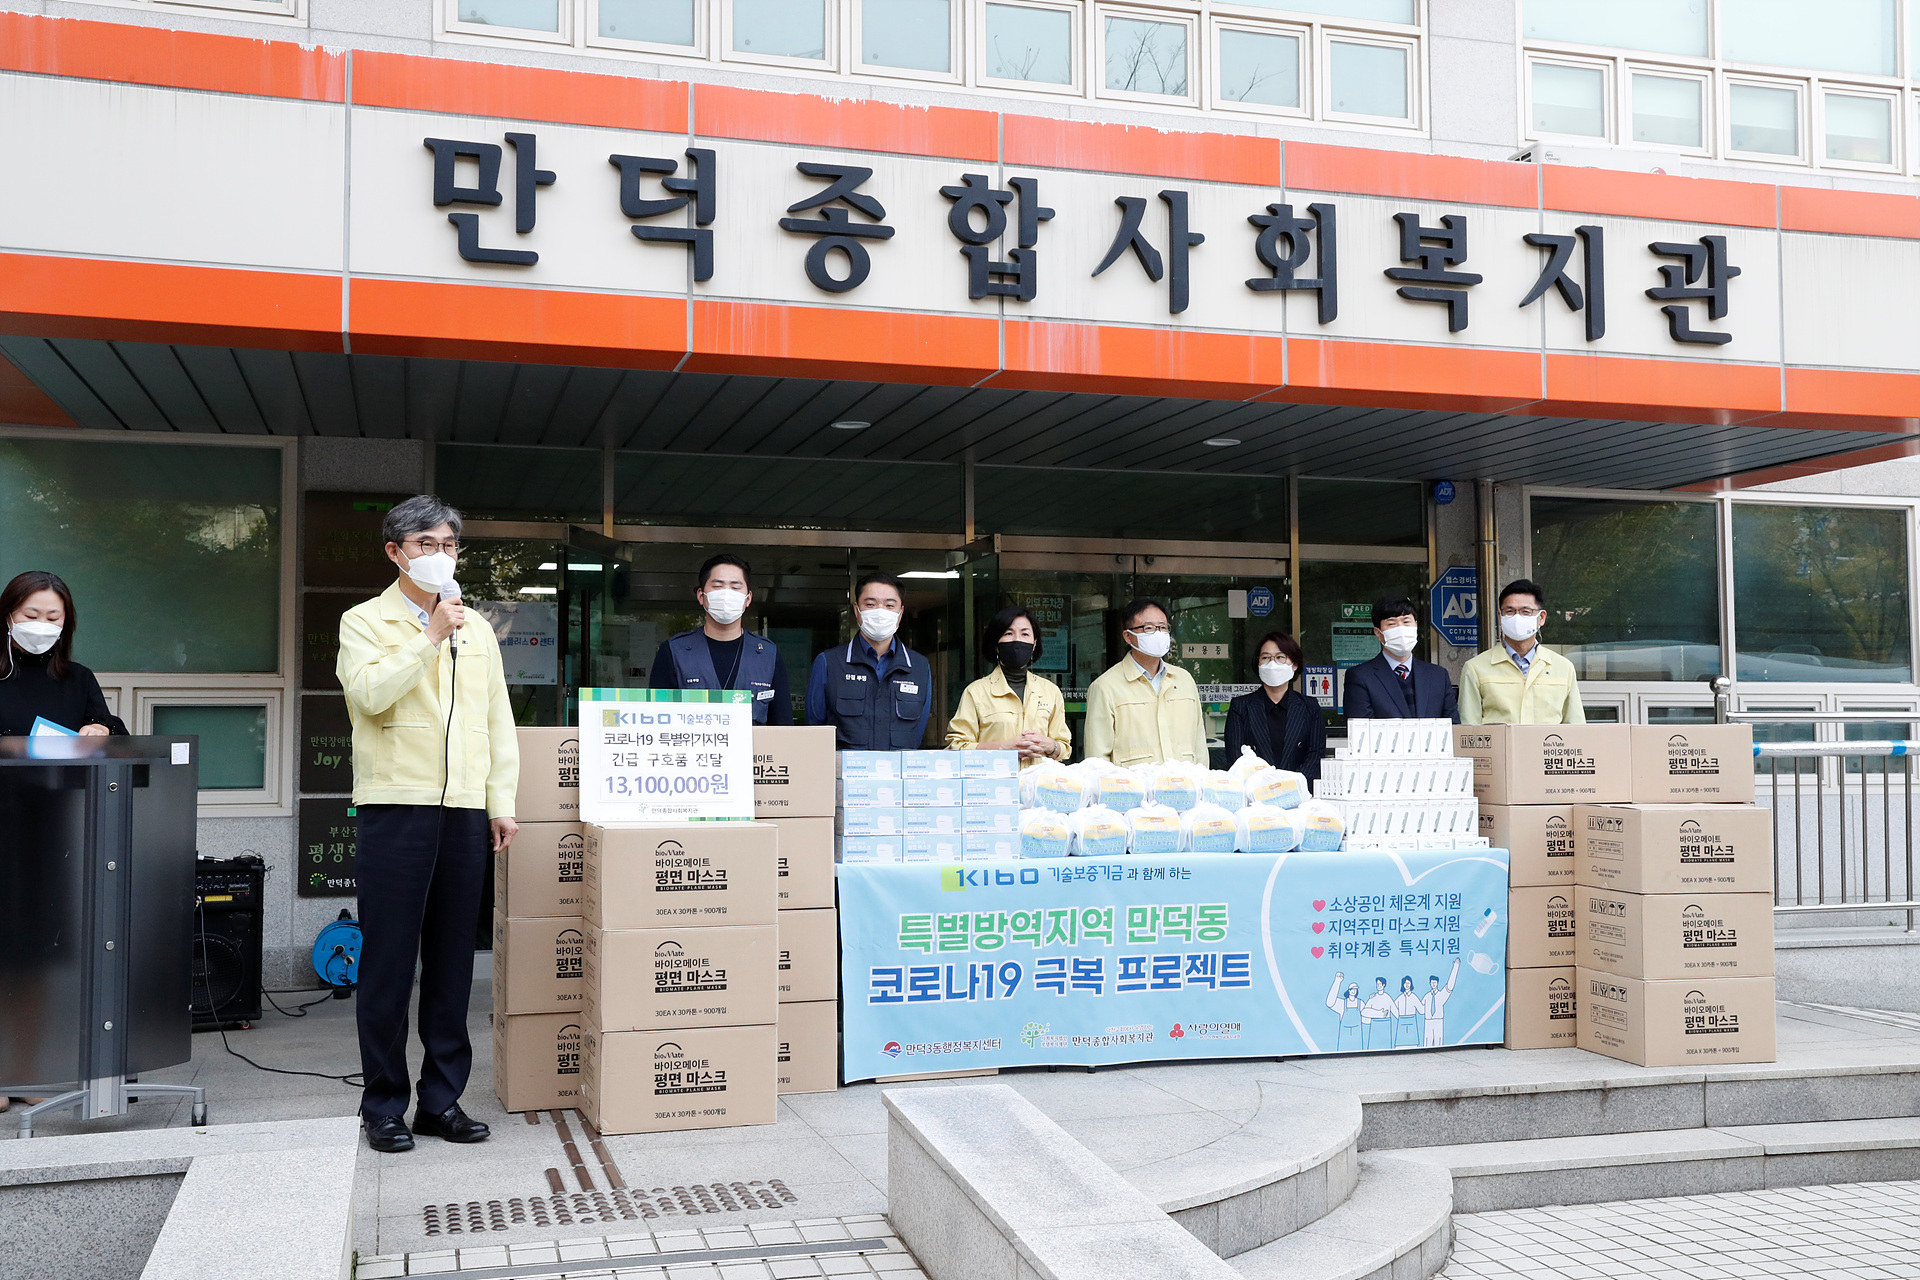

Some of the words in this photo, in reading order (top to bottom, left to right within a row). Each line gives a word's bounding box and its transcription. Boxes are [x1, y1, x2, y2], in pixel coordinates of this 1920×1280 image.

[424, 132, 1741, 345] 만덕종합사회복지관
[677, 713, 730, 726] 기술보증기금
[604, 732, 653, 746] 코로나19
[658, 732, 729, 747] 특별위기지역
[1544, 748, 1583, 756] 바이오메이트
[1668, 749, 1707, 757] 바이오메이트
[313, 752, 341, 769] Joy
[612, 752, 639, 767] 긴급
[647, 752, 688, 767] 구호품
[695, 752, 723, 767] 전달
[1544, 758, 1563, 769] 평면
[1567, 758, 1595, 769] 마스크
[1669, 758, 1688, 769] 평면
[1691, 758, 1719, 769] 마스크
[753, 765, 789, 778] 마스크
[605, 774, 729, 796] 13,100,000원
[1546, 840, 1565, 851] 평면
[1680, 835, 1721, 843] 바이오메이트
[1680, 845, 1700, 857] 평면
[1704, 845, 1734, 857] 마스크
[558, 862, 583, 875] 평면
[655, 858, 710, 868] 바이오메이트
[655, 870, 682, 885] 평면
[688, 869, 728, 884] 마스크
[1047, 865, 1123, 883] 기술보증기금
[1127, 868, 1139, 880] 과
[1142, 867, 1165, 880] 함께
[1169, 866, 1192, 880] 하는
[1329, 895, 1385, 913] 소상공인
[1389, 893, 1430, 912] 체온계
[1434, 893, 1462, 910] 지원
[898, 906, 1114, 953] 특별방역지역
[1126, 904, 1229, 945] 만덕동
[1328, 917, 1384, 936] 지역주민
[1389, 916, 1429, 934] 마스크
[1434, 915, 1460, 933] 지원
[1548, 920, 1567, 932] 평면
[1682, 920, 1724, 928] 바이오메이트
[1683, 930, 1703, 942] 평면
[1707, 929, 1737, 941] 마스크
[1327, 940, 1392, 959] 취약계층
[1399, 937, 1460, 957] 특식지원
[556, 957, 582, 971] 평면
[655, 958, 710, 969] 바이오메이트
[655, 971, 682, 986] 평면
[687, 969, 727, 984] 마스크
[869, 962, 1023, 1004] 코로나19
[1033, 958, 1104, 995] 극복
[1116, 952, 1251, 992] 프로젝트
[1550, 1002, 1569, 1013] 평면
[1684, 1005, 1726, 1014] 바이오메이트
[1187, 1022, 1241, 1034] 사랑의열매
[1685, 1016, 1705, 1028] 평면
[1709, 1015, 1739, 1027] 마스크
[1072, 1032, 1153, 1047] 만덕종합사회복지관
[906, 1038, 1001, 1056] 만덕3동행정복지센터
[654, 1059, 710, 1070] 바이오메이트
[654, 1072, 682, 1087] 평면
[687, 1071, 727, 1085] 마스크
